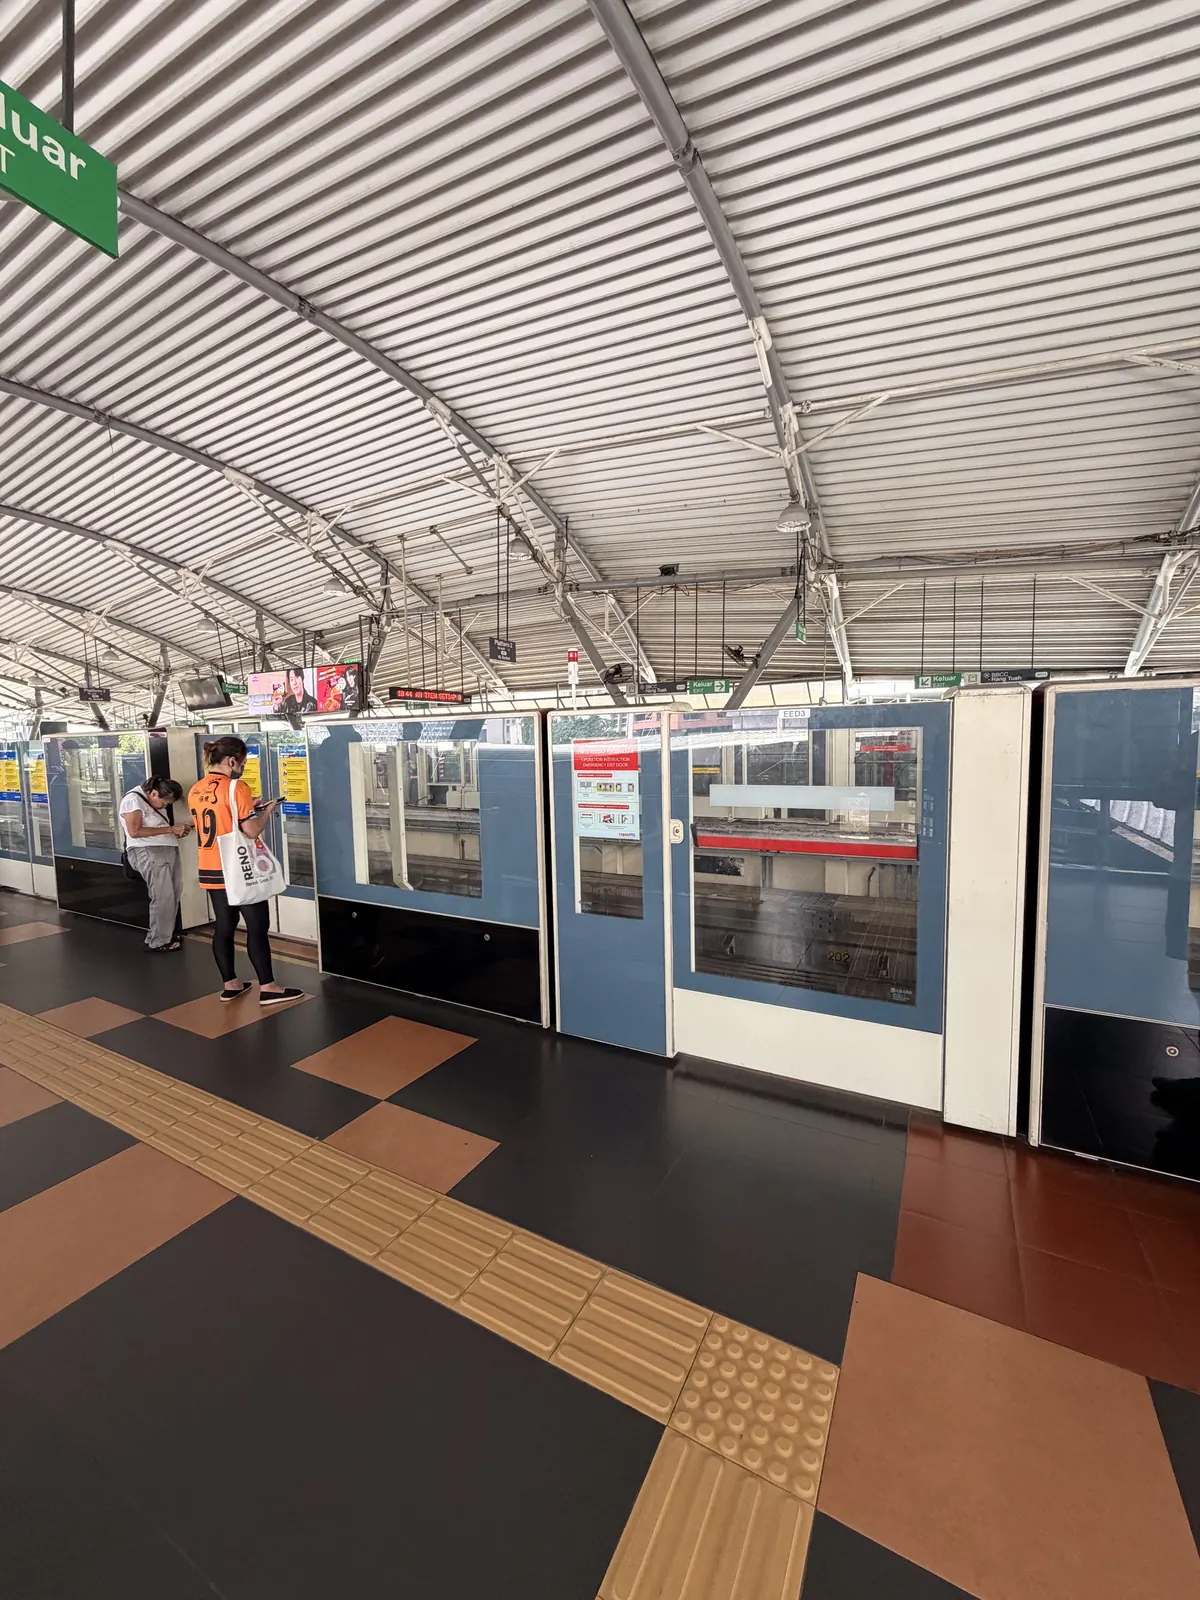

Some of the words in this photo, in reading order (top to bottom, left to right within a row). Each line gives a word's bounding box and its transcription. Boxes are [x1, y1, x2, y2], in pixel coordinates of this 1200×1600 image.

[783, 710, 806, 718] EED3
[191, 808, 217, 848] 19
[237, 845, 254, 881] RENO
[827, 950, 850, 963] 202
